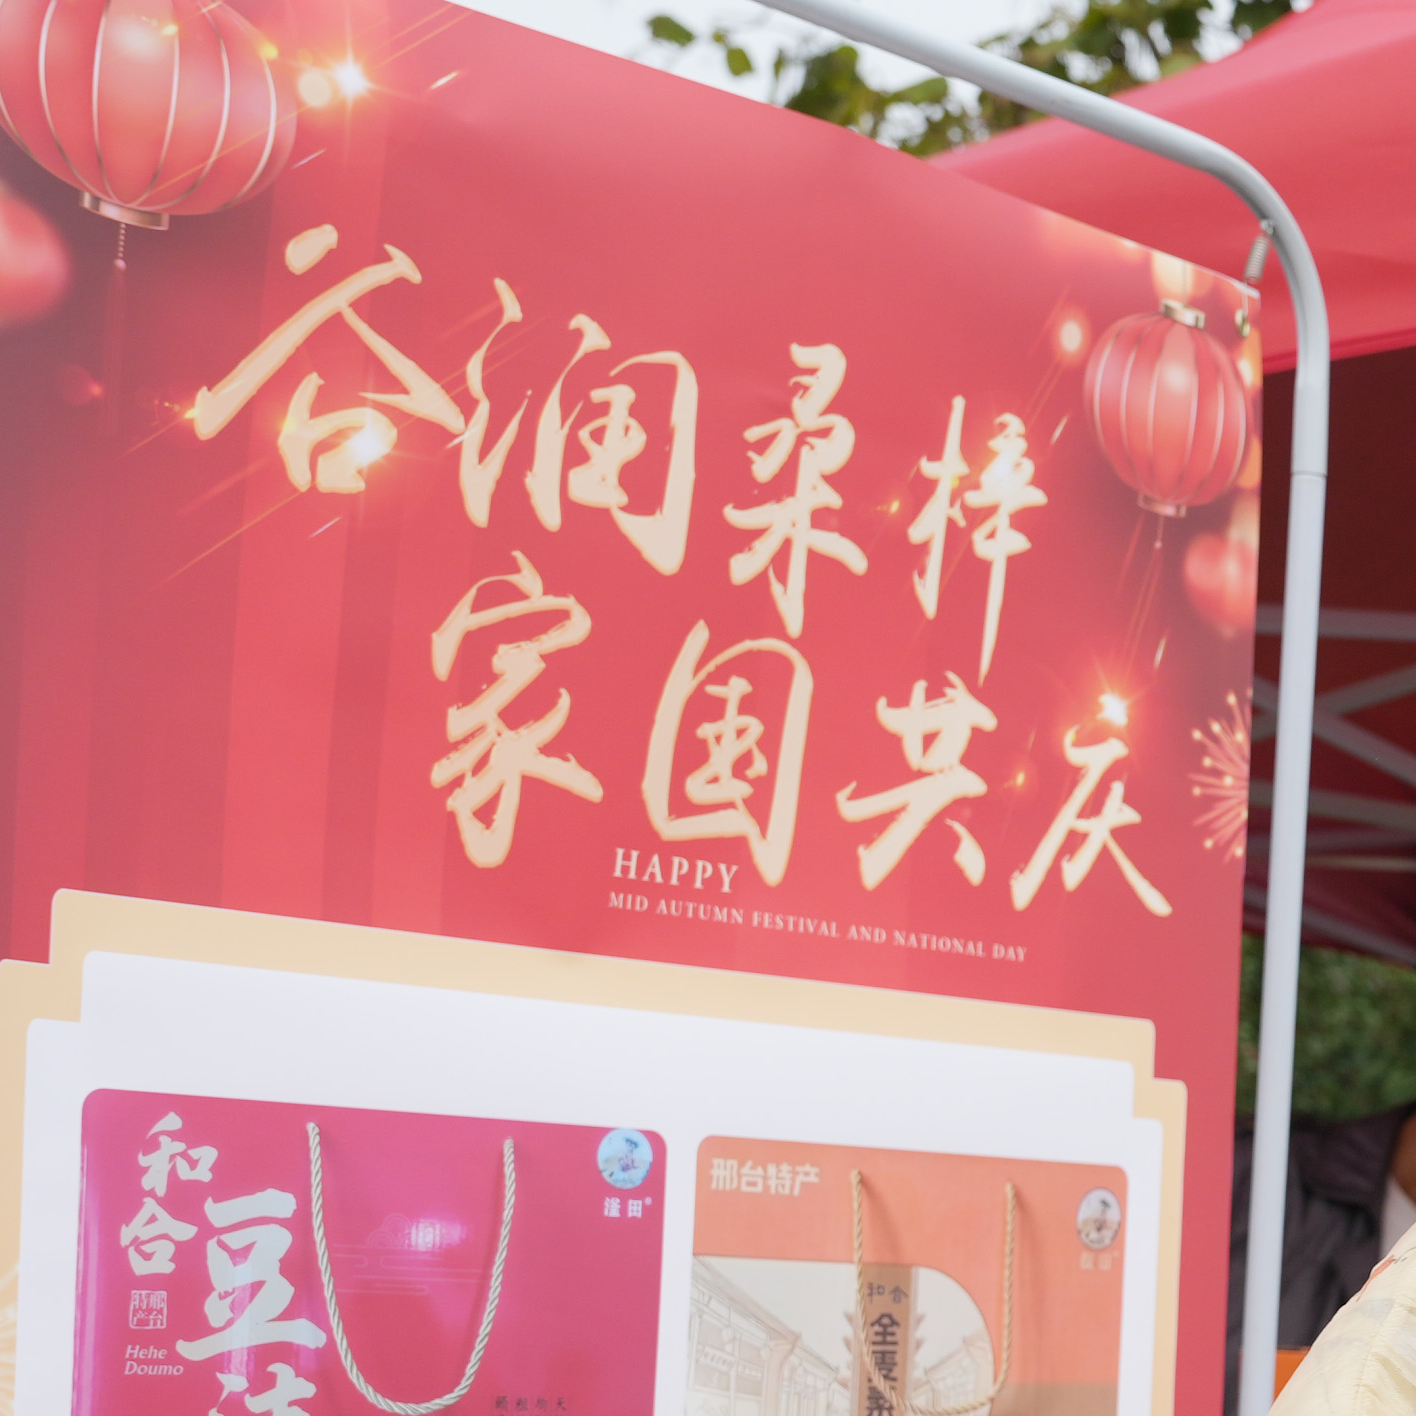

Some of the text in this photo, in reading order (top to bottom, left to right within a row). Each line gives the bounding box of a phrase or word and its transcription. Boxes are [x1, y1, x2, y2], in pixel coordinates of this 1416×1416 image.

[193, 222, 1048, 690] 谷润桑梓
[430, 550, 1173, 918] 家国共庆
[613, 847, 740, 894] HAPPY
[609, 891, 1028, 963] MID AUTUMN FESTIVAL AND NATIONAL DAY
[119, 1111, 219, 1276] 和合
[709, 1157, 821, 1197] 邢台特产
[867, 1282, 908, 1305] 和合
[124, 1360, 185, 1376] Doumo
[125, 1344, 168, 1360] Hehe
